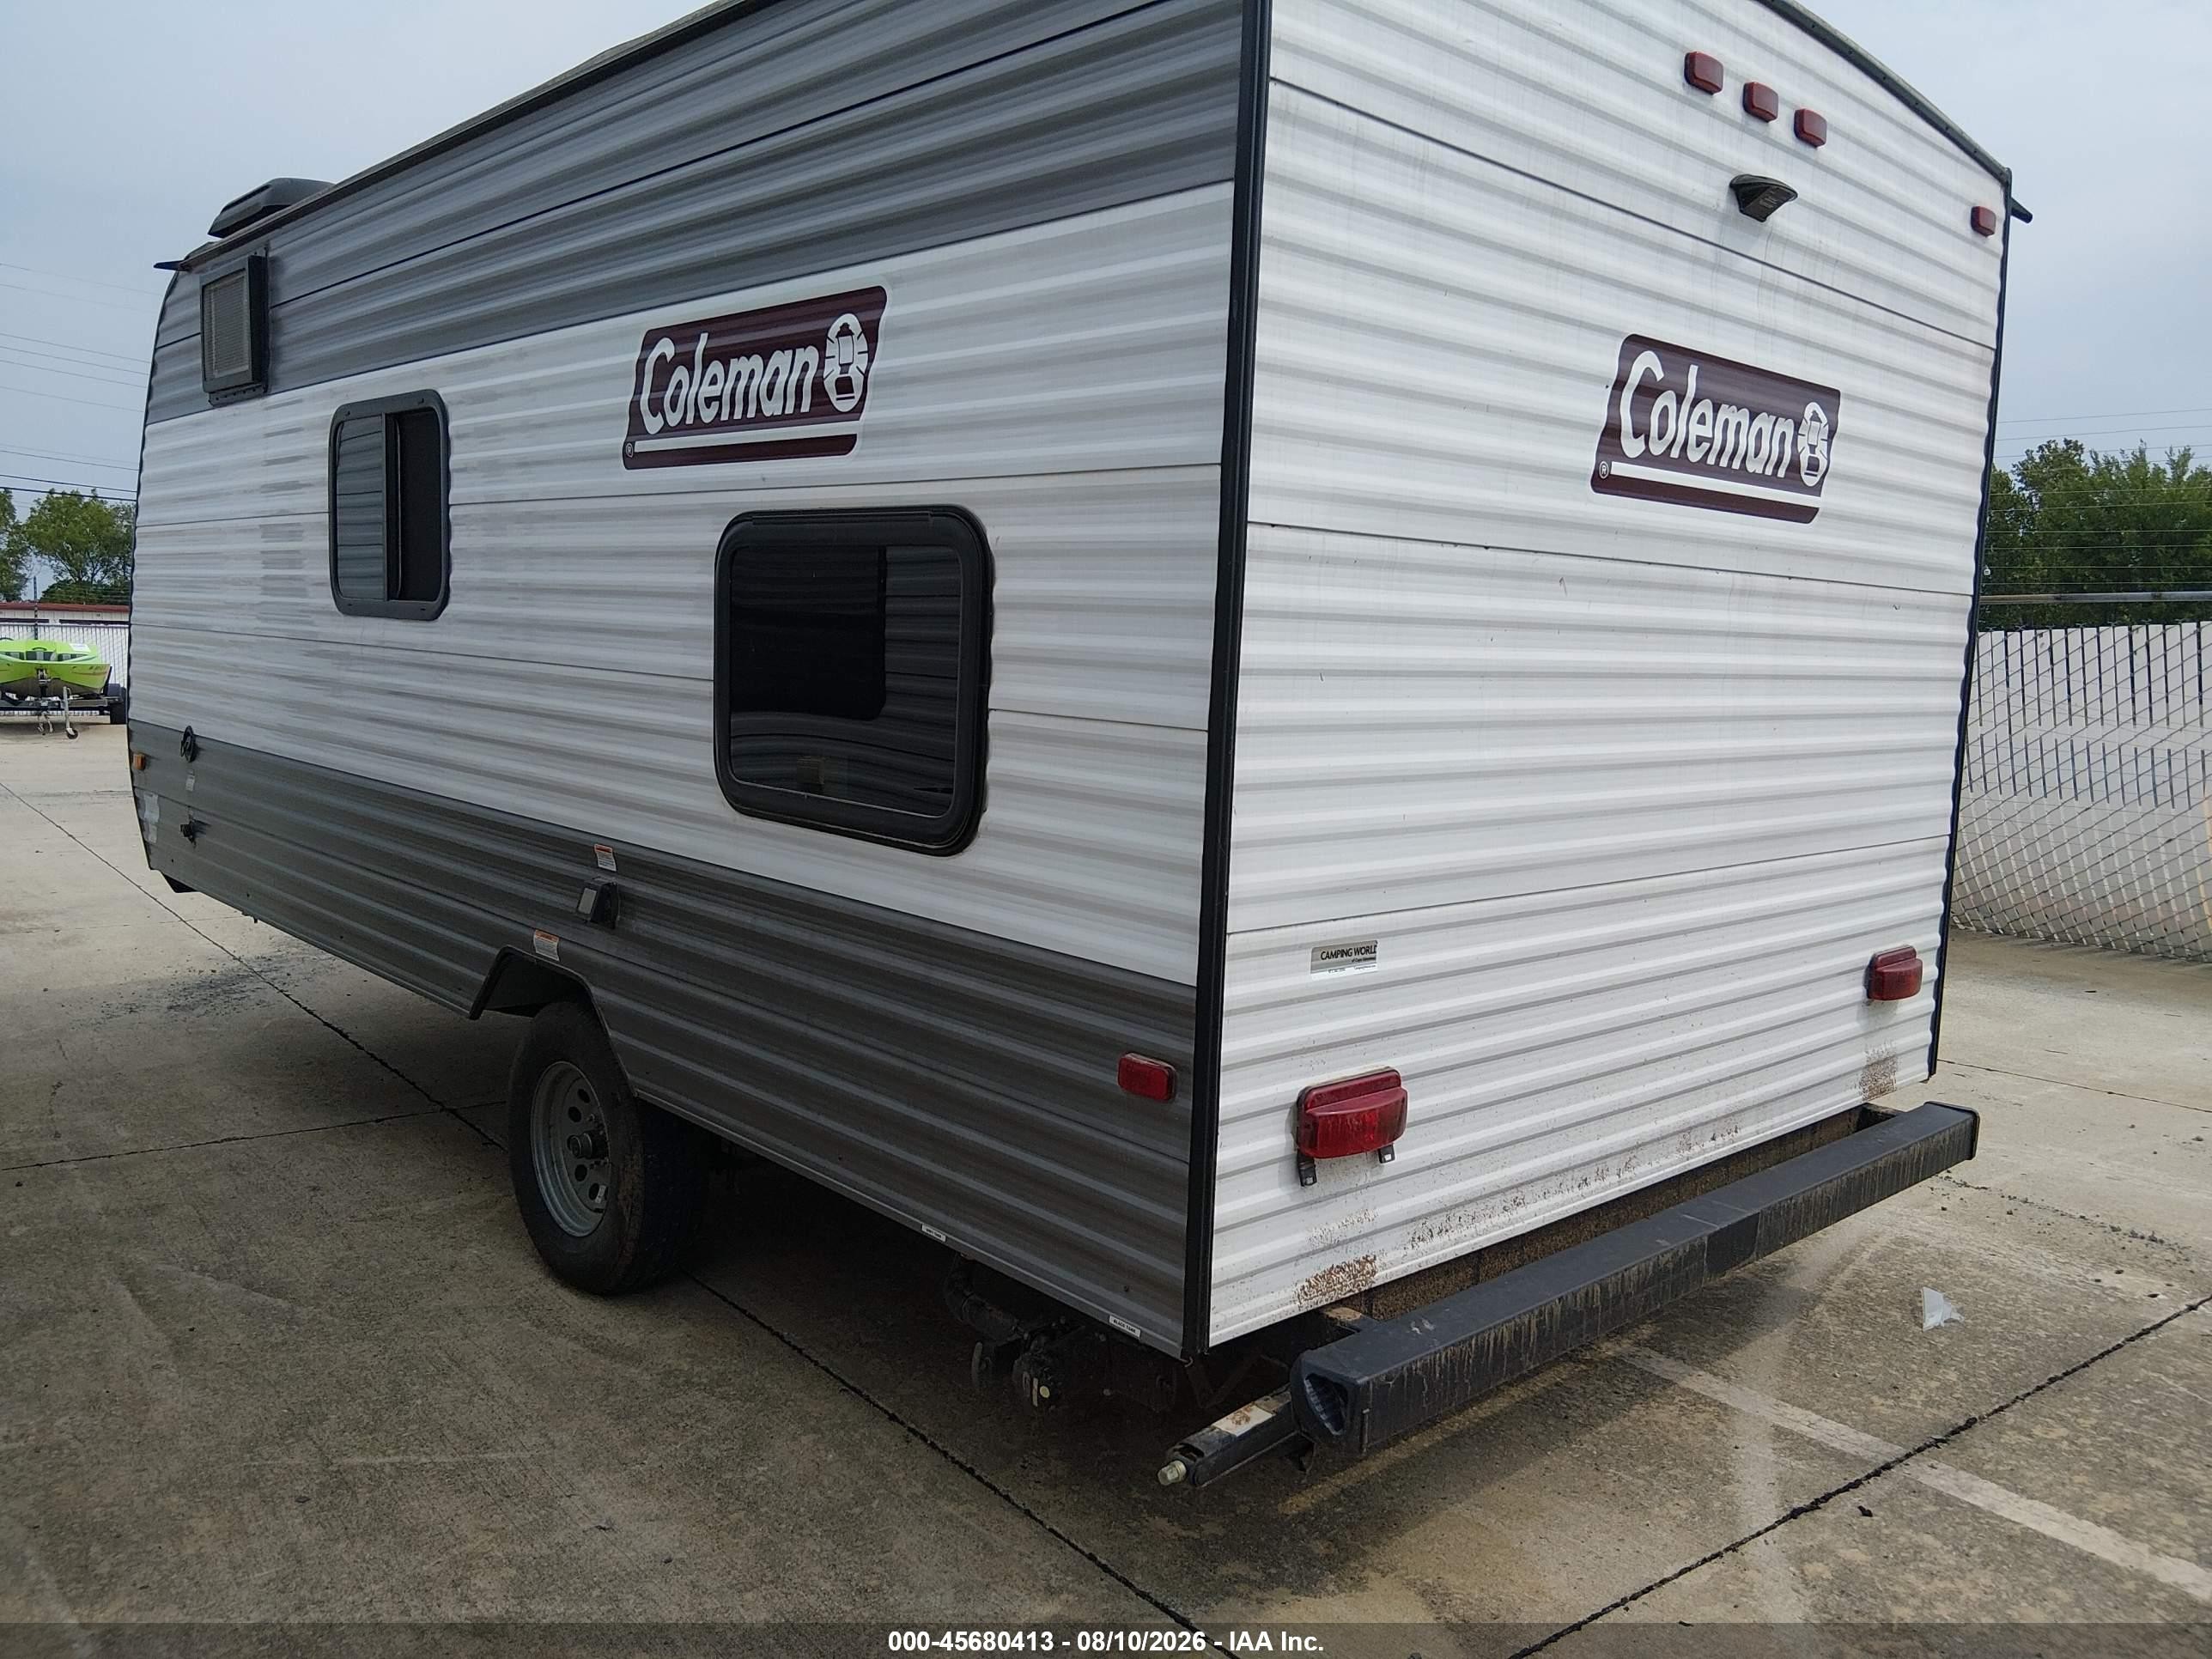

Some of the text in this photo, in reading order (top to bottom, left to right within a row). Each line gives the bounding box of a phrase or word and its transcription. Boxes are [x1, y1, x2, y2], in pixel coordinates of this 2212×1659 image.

[640, 332, 819, 434] Coleman
[1620, 350, 1795, 478] Coleman
[1320, 947, 1353, 960] CAMPING
